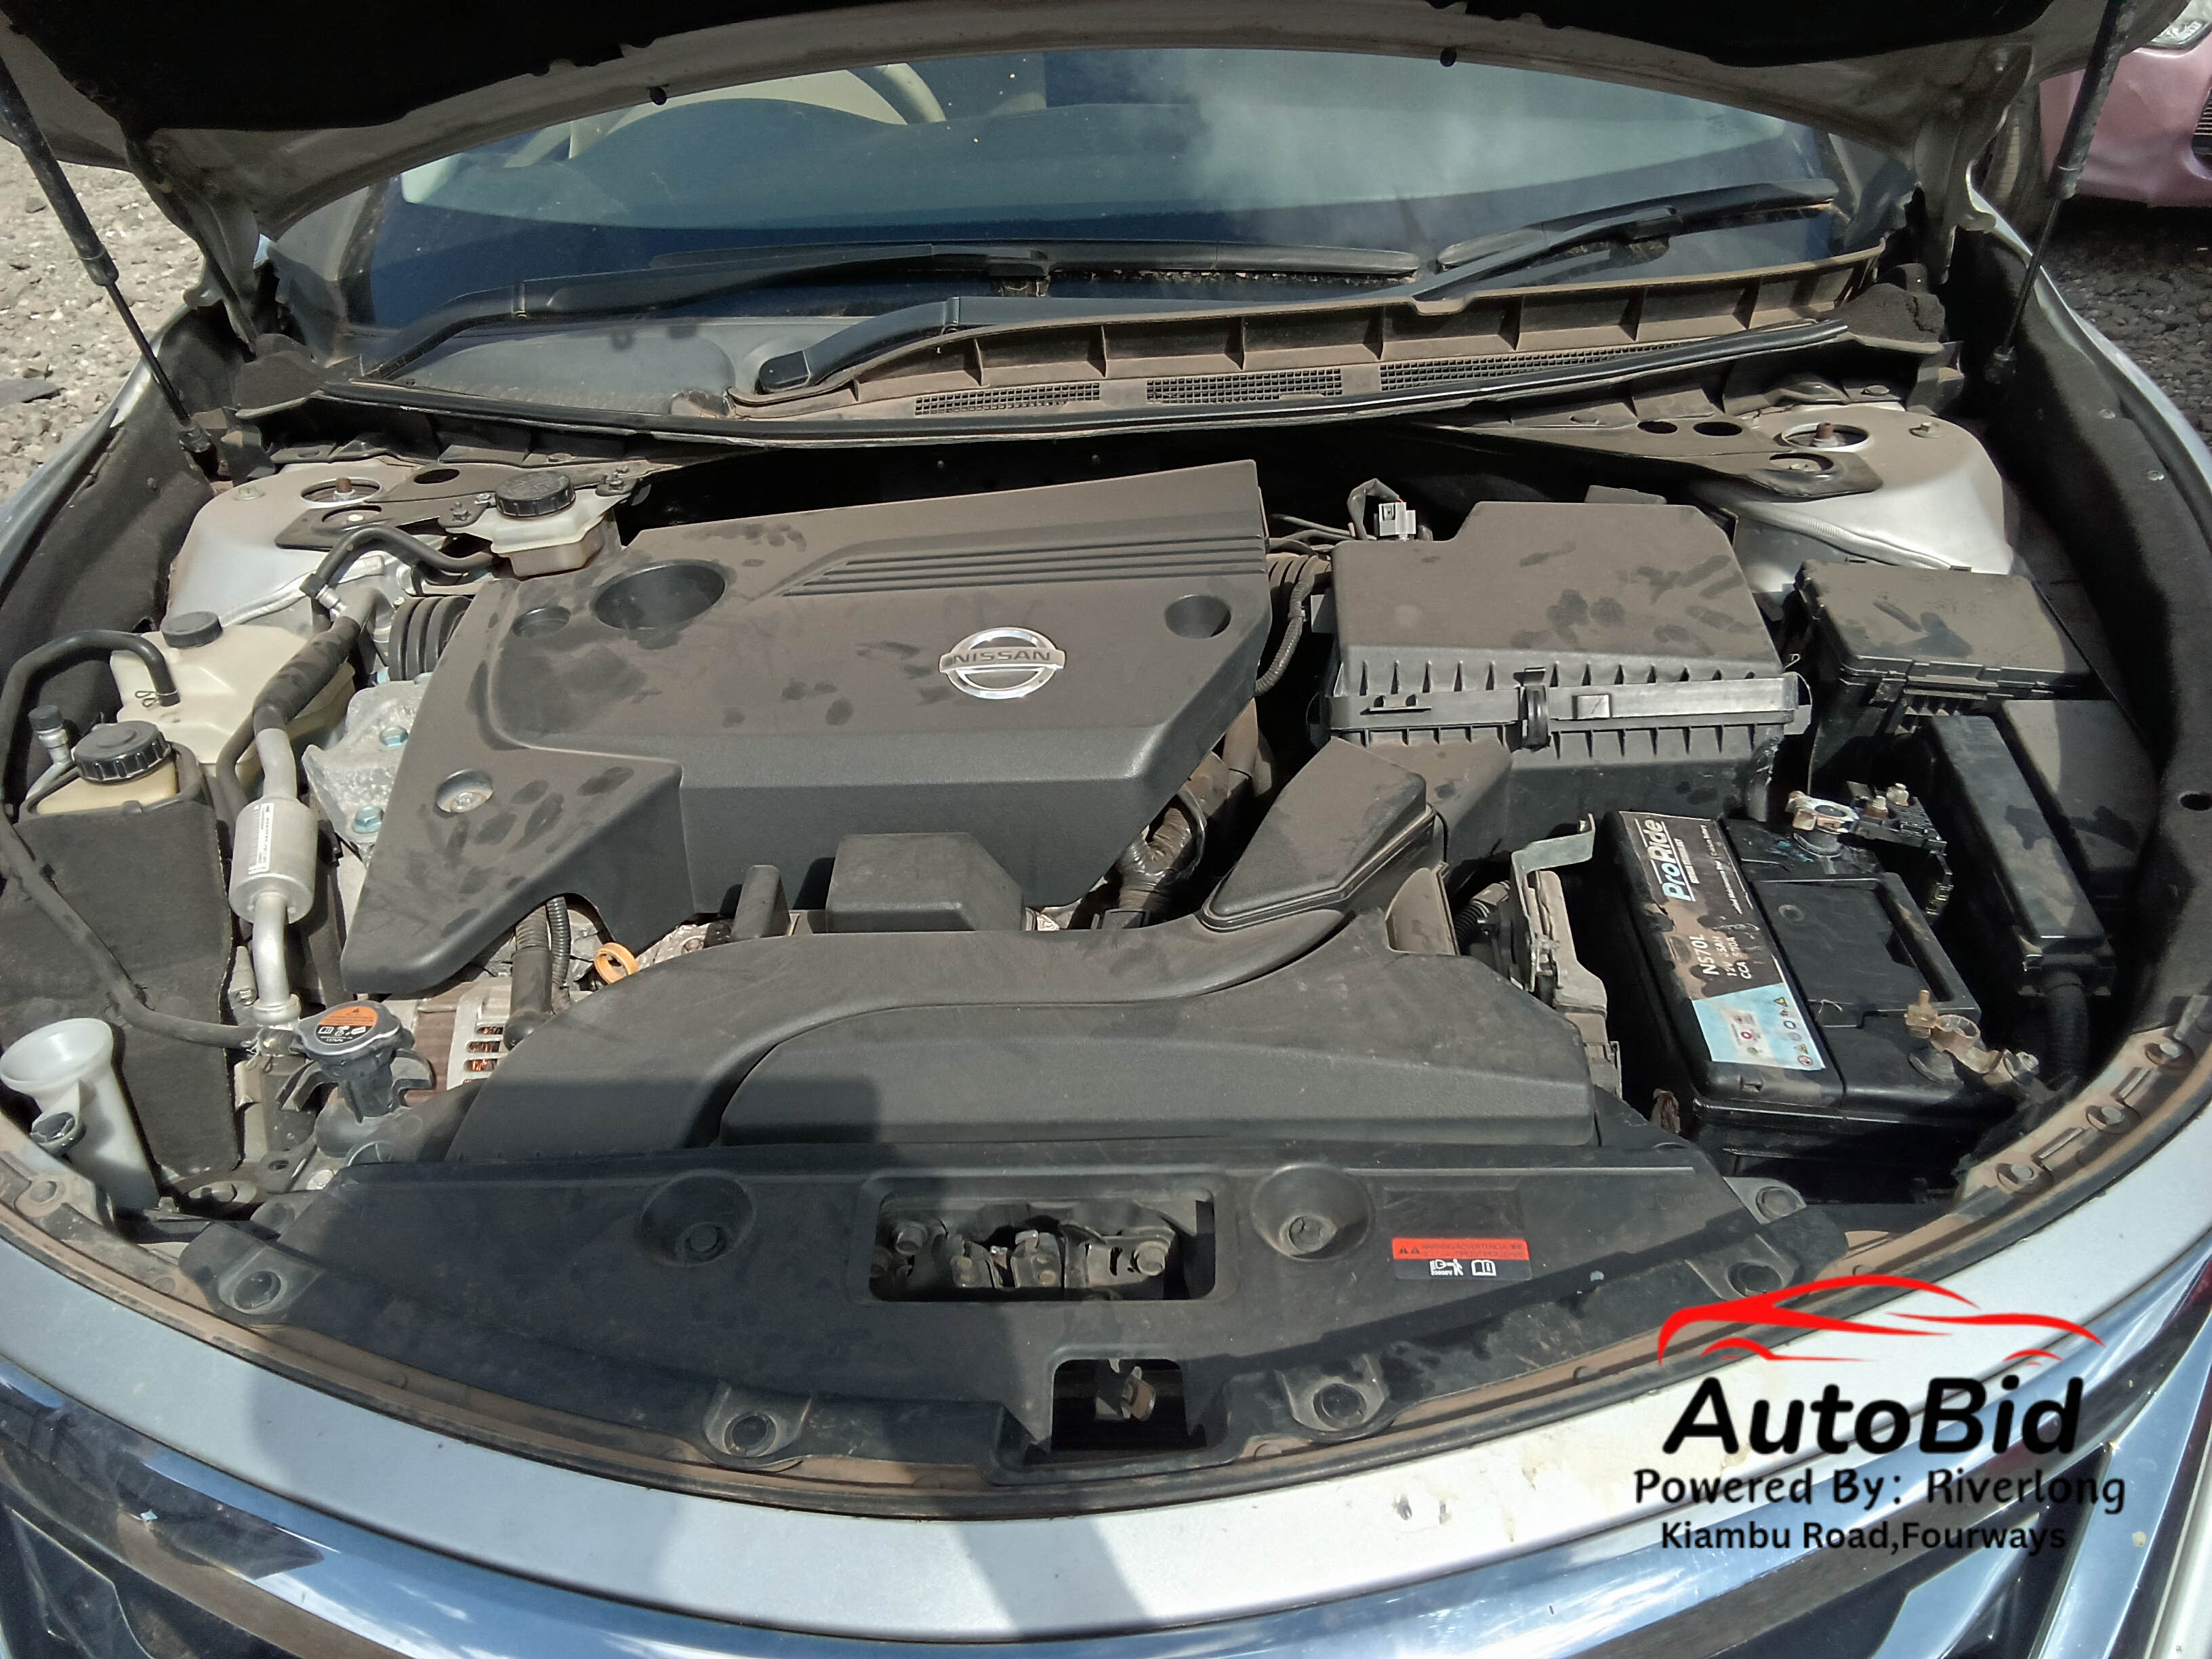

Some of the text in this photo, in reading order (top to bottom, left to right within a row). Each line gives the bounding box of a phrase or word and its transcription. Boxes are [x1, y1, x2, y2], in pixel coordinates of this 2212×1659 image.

[953, 650, 1050, 665] NISSAN
[1642, 819, 1692, 901] ProRide
[1689, 935, 1720, 975] NS70L
[1736, 961, 1752, 979] CCA
